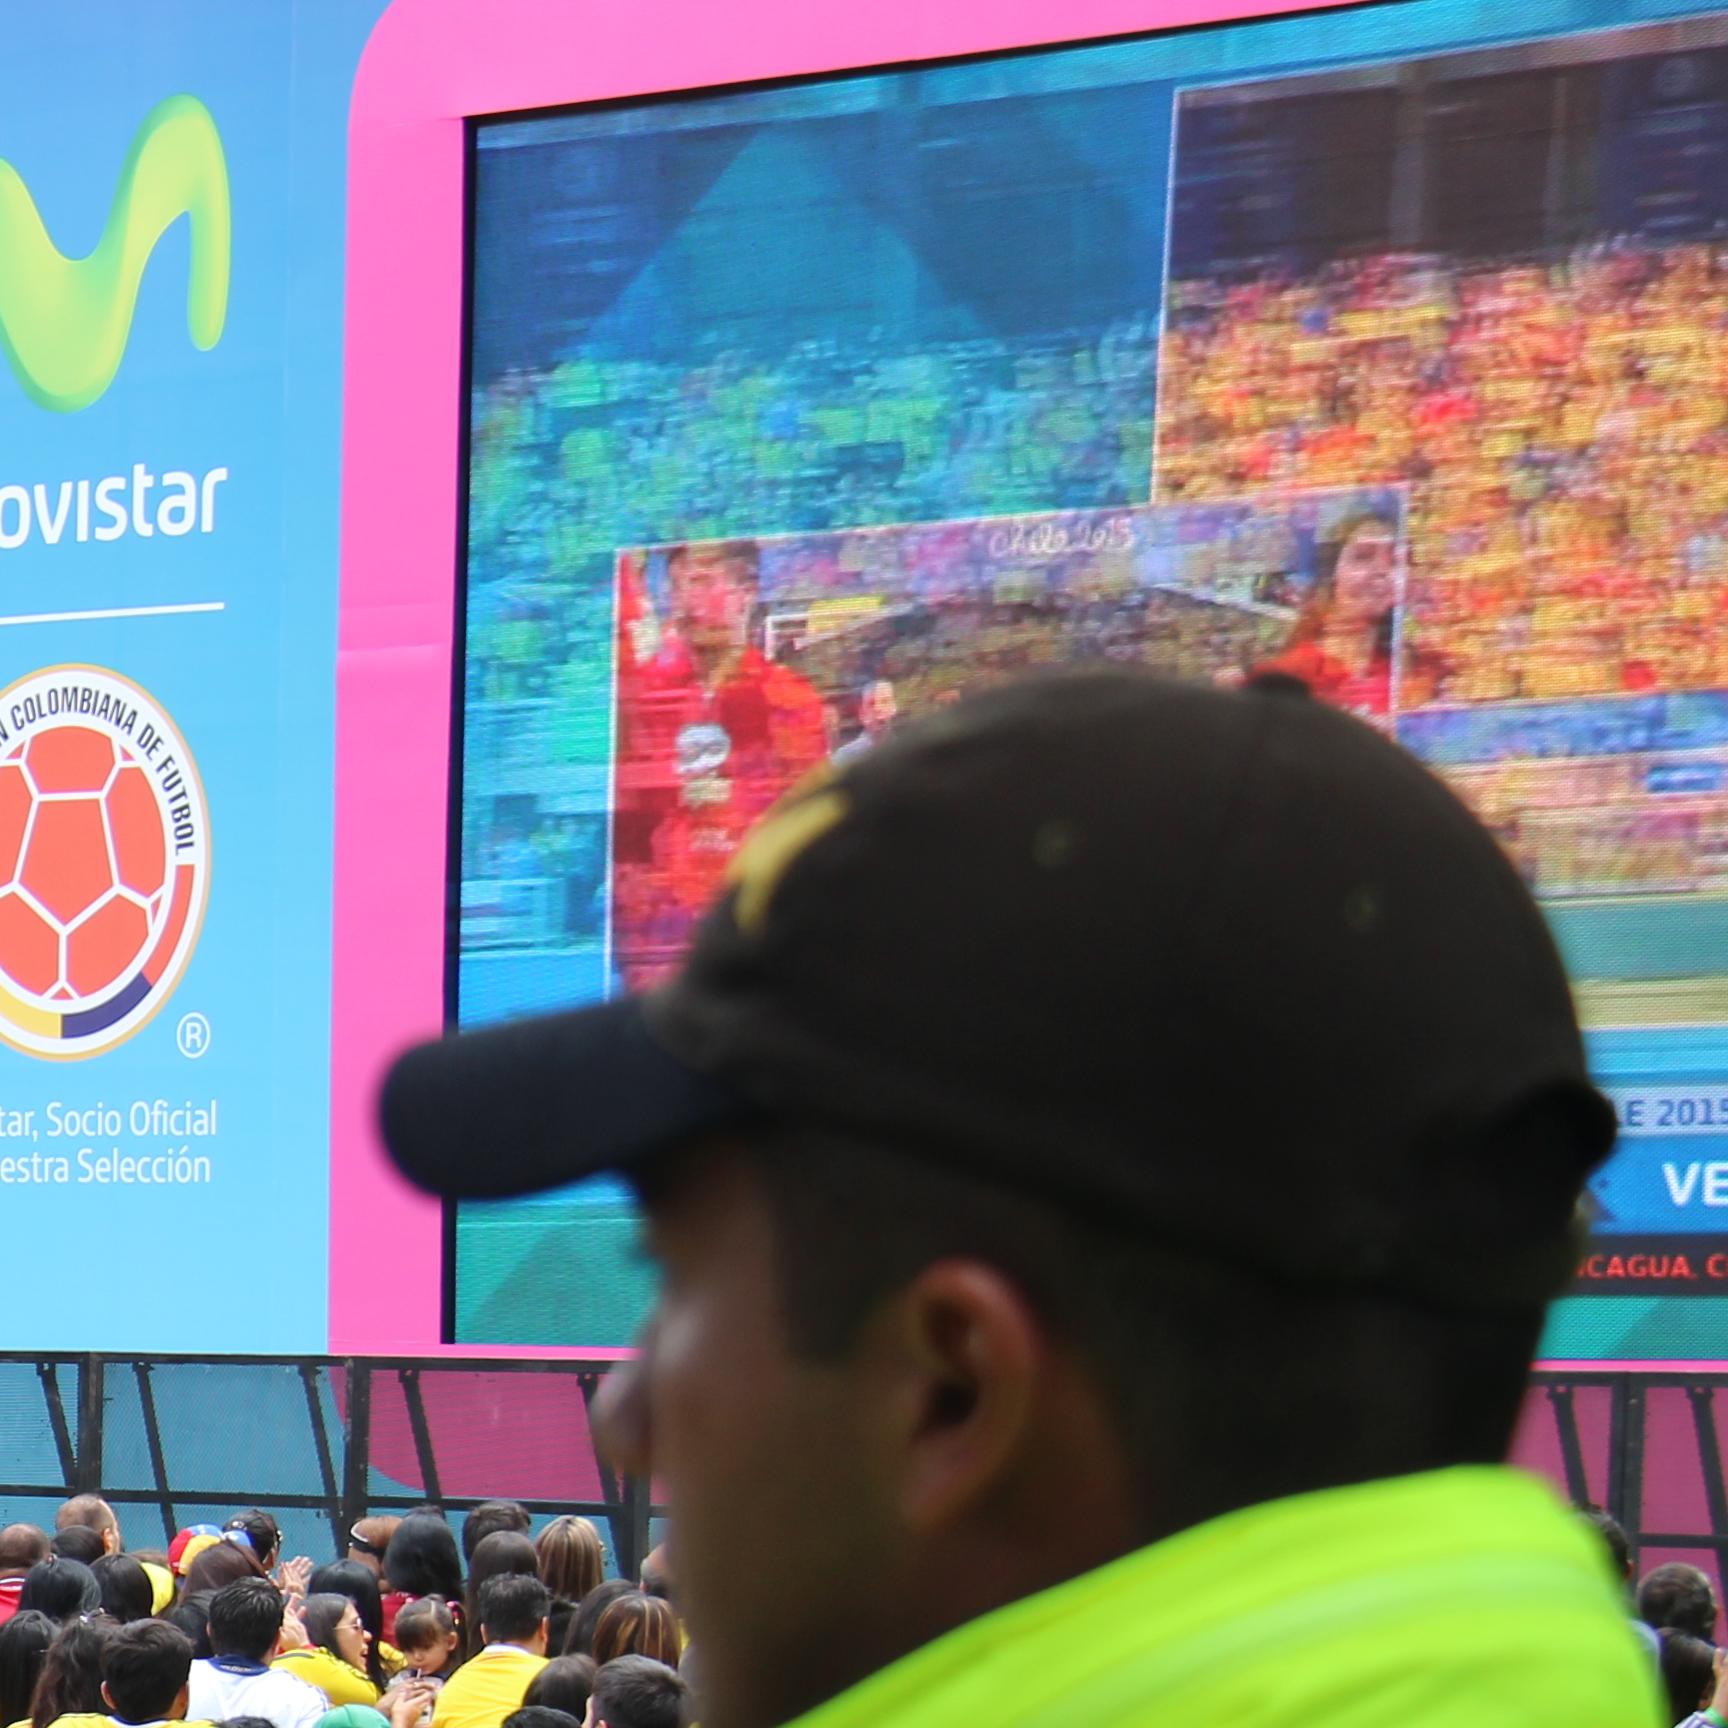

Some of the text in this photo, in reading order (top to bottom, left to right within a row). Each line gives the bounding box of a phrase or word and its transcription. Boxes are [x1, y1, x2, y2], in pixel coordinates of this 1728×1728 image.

[9, 686, 139, 737] COLOMBIANA
[135, 722, 165, 762] DE
[155, 754, 195, 857] FUTBOL
[46, 1100, 121, 1137] Socio
[129, 1098, 218, 1137] Oficial
[76, 1144, 211, 1183] Selección
